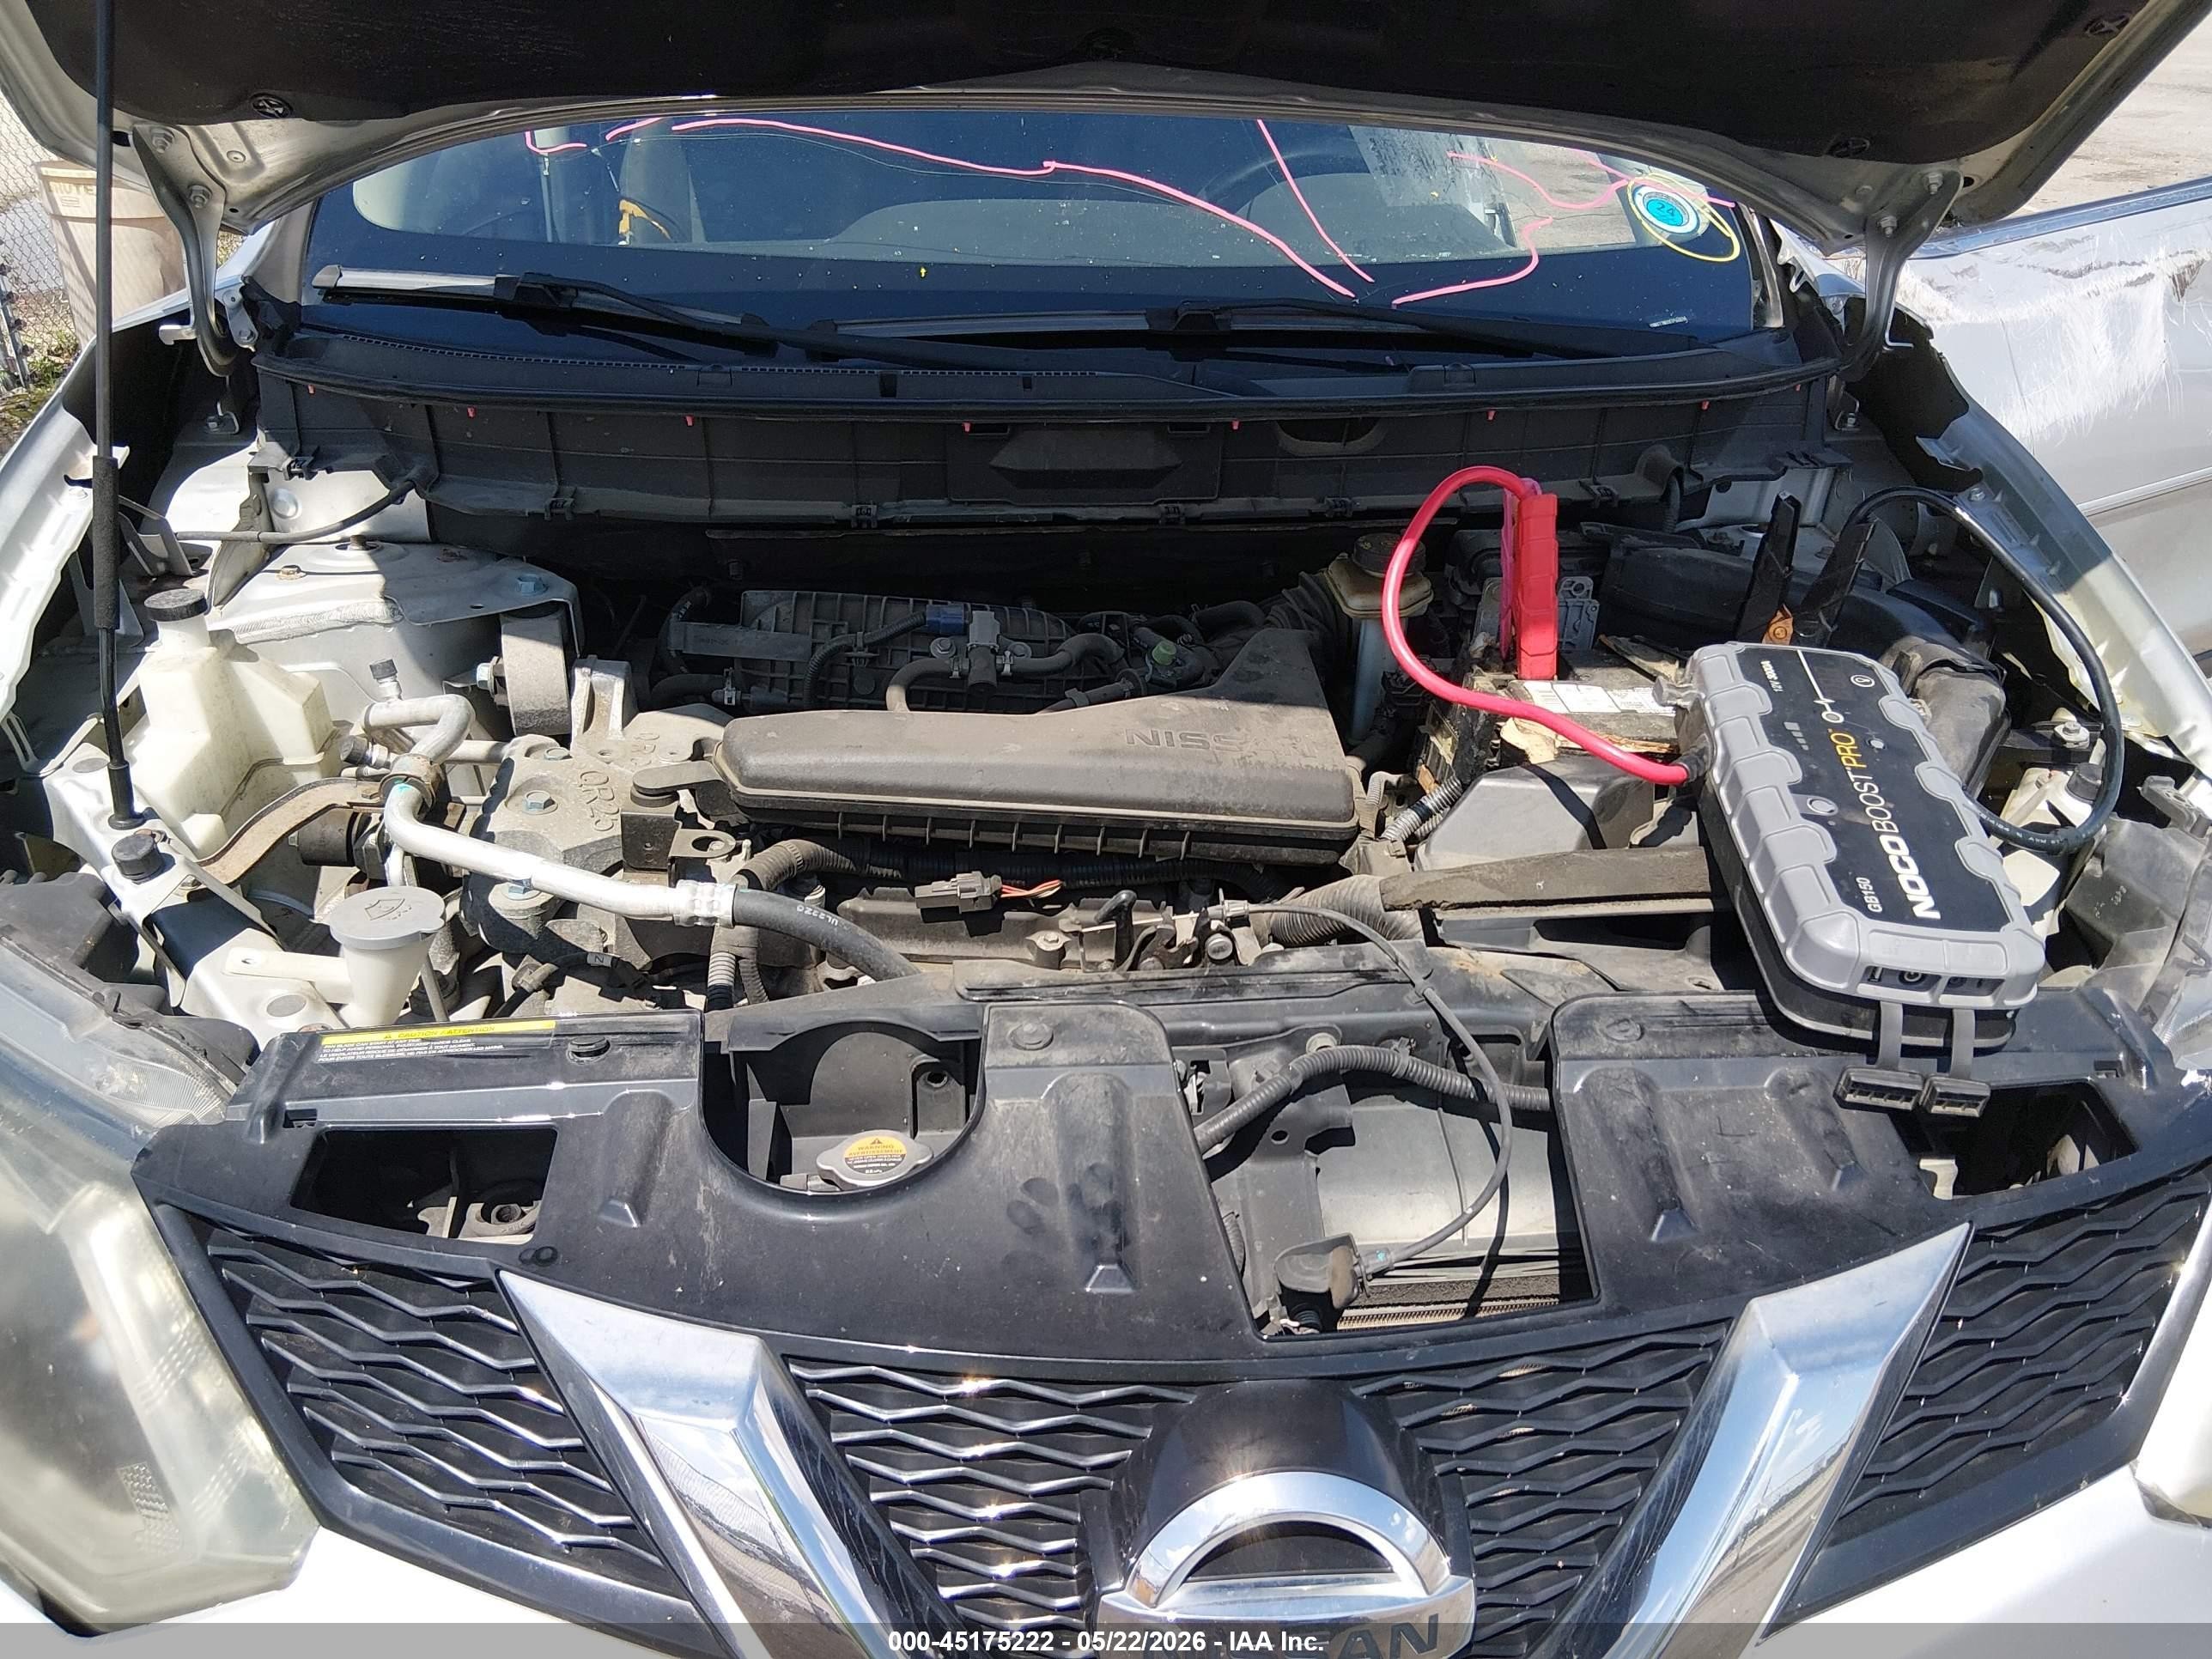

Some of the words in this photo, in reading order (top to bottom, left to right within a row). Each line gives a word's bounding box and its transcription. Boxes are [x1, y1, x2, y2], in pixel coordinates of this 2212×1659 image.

[1830, 732, 1867, 769] PRO
[1847, 769, 1899, 834] BOOST
[1856, 877, 1883, 913] GB150
[1879, 834, 1942, 921] NOCO
[398, 1030, 436, 1038] CAUTION
[446, 1026, 495, 1035] ATTENTION
